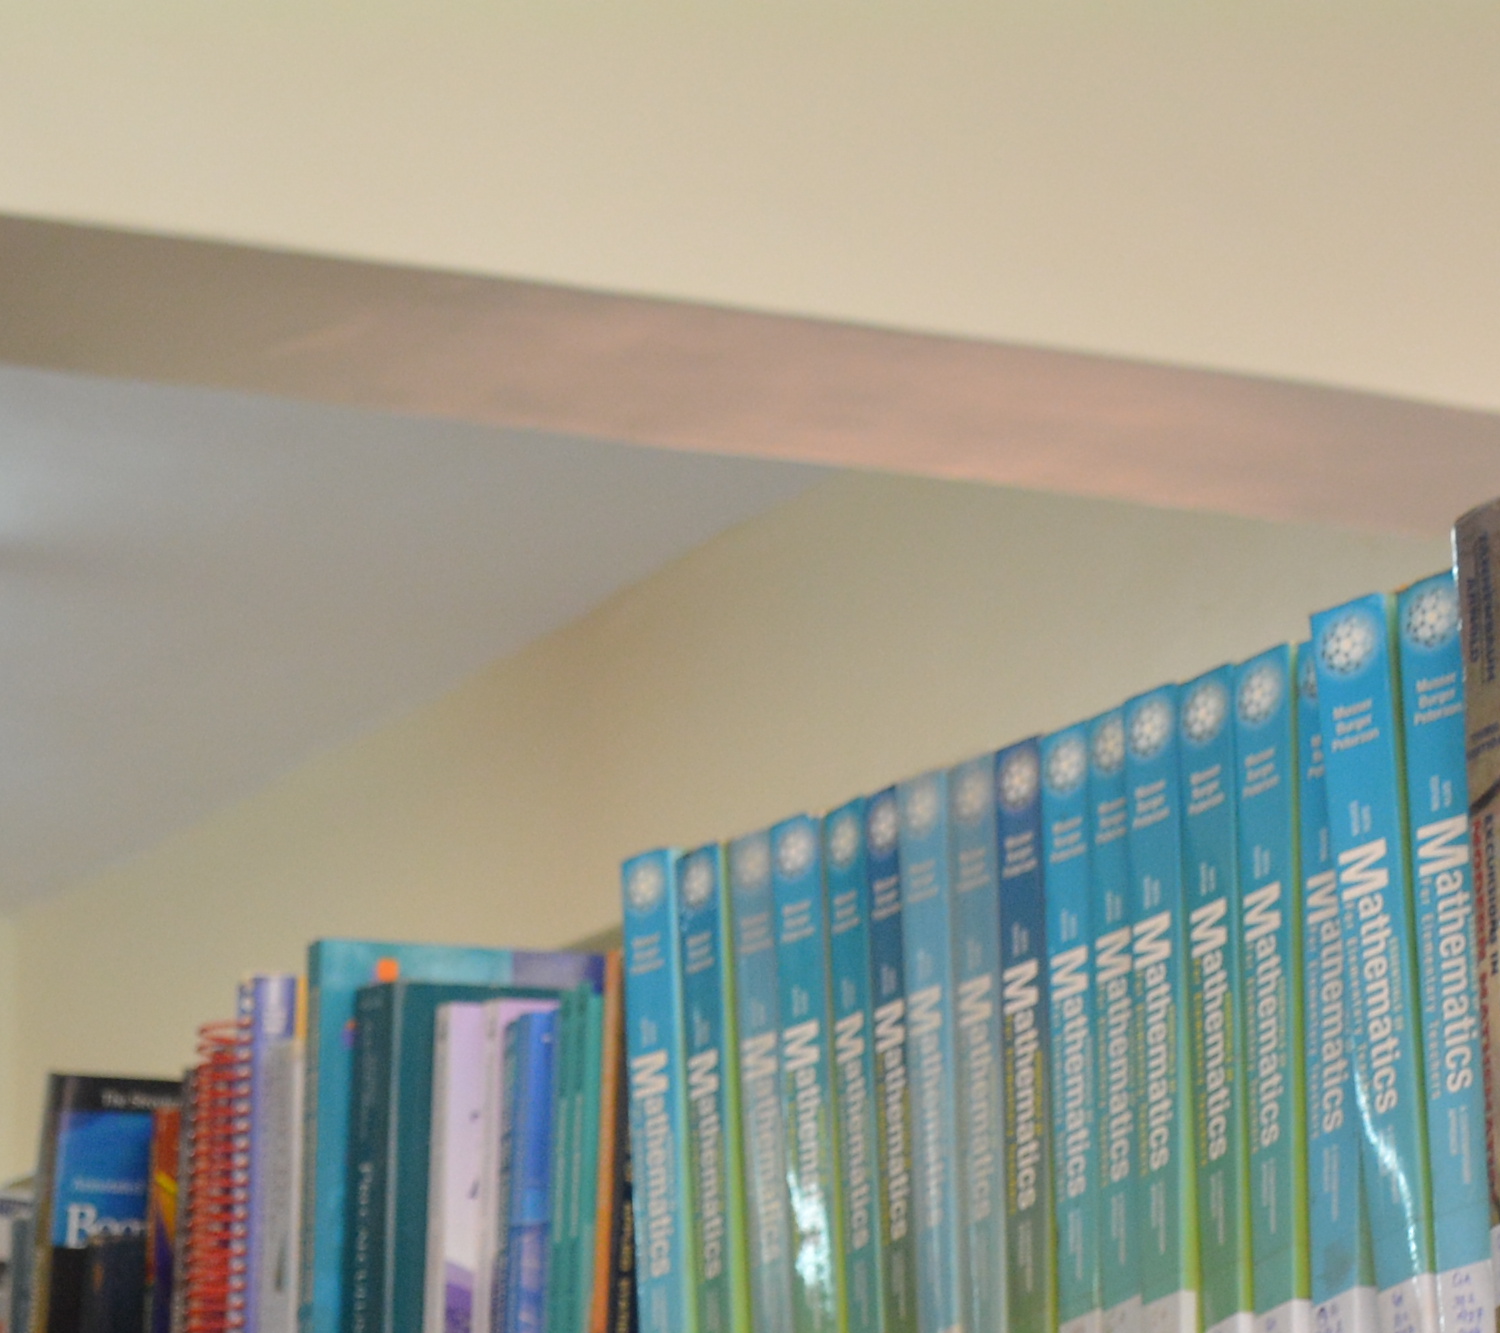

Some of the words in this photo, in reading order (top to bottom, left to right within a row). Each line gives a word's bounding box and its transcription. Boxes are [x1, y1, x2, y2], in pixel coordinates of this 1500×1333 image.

[1416, 814, 1473, 1091] Mathematics
[631, 1052, 670, 1277] Mathematics
[1001, 960, 1036, 1210] Mathematics
